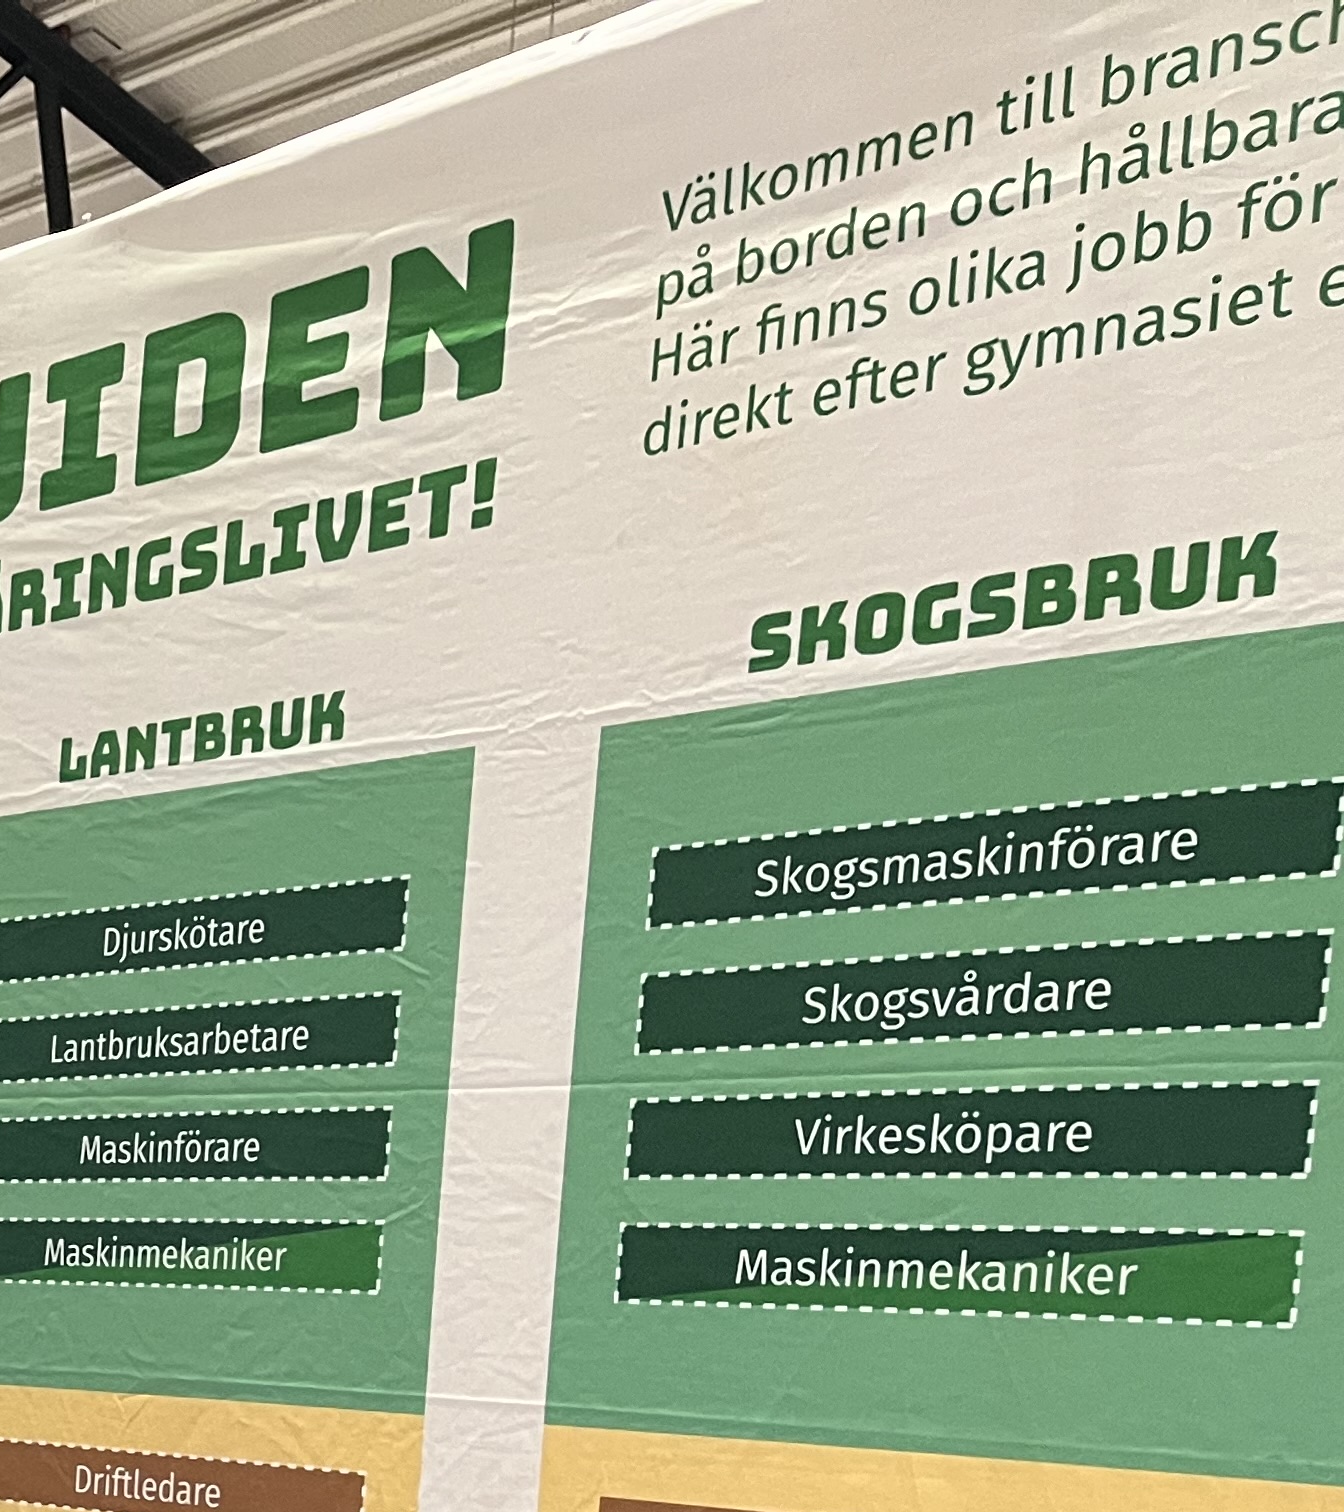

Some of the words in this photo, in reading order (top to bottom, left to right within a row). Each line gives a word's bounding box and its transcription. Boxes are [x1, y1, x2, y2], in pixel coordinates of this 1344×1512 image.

[661, 111, 974, 232] Välkommen
[997, 66, 1074, 135] till
[656, 244, 713, 320] på
[736, 200, 926, 286] borden
[951, 158, 1051, 226] och
[1080, 91, 1344, 194] hållbara
[652, 320, 740, 382] Här
[756, 290, 886, 355] finns
[910, 247, 1045, 315] olika
[1066, 199, 1211, 293] jobb
[1238, 172, 1338, 239] för
[644, 382, 793, 455] direkt
[814, 352, 947, 415] efter
[964, 266, 1292, 395] gymnasiet
[748, 531, 1278, 673] SKOGSBRUK
[59, 690, 345, 783] LANTBRUK
[754, 824, 1198, 901] Skogsmaskinförare
[103, 916, 265, 963] Djurskötare
[802, 970, 1111, 1030] Skogsvårdare
[52, 1023, 308, 1063] Lantbruksarbetare
[80, 1130, 259, 1164] Maskinförare
[796, 1112, 1092, 1163] Virkesköpare
[45, 1236, 287, 1271] Maskinmekaniker
[736, 1247, 1138, 1295] Maskinmekaniker
[76, 1465, 220, 1507] Driftledare
